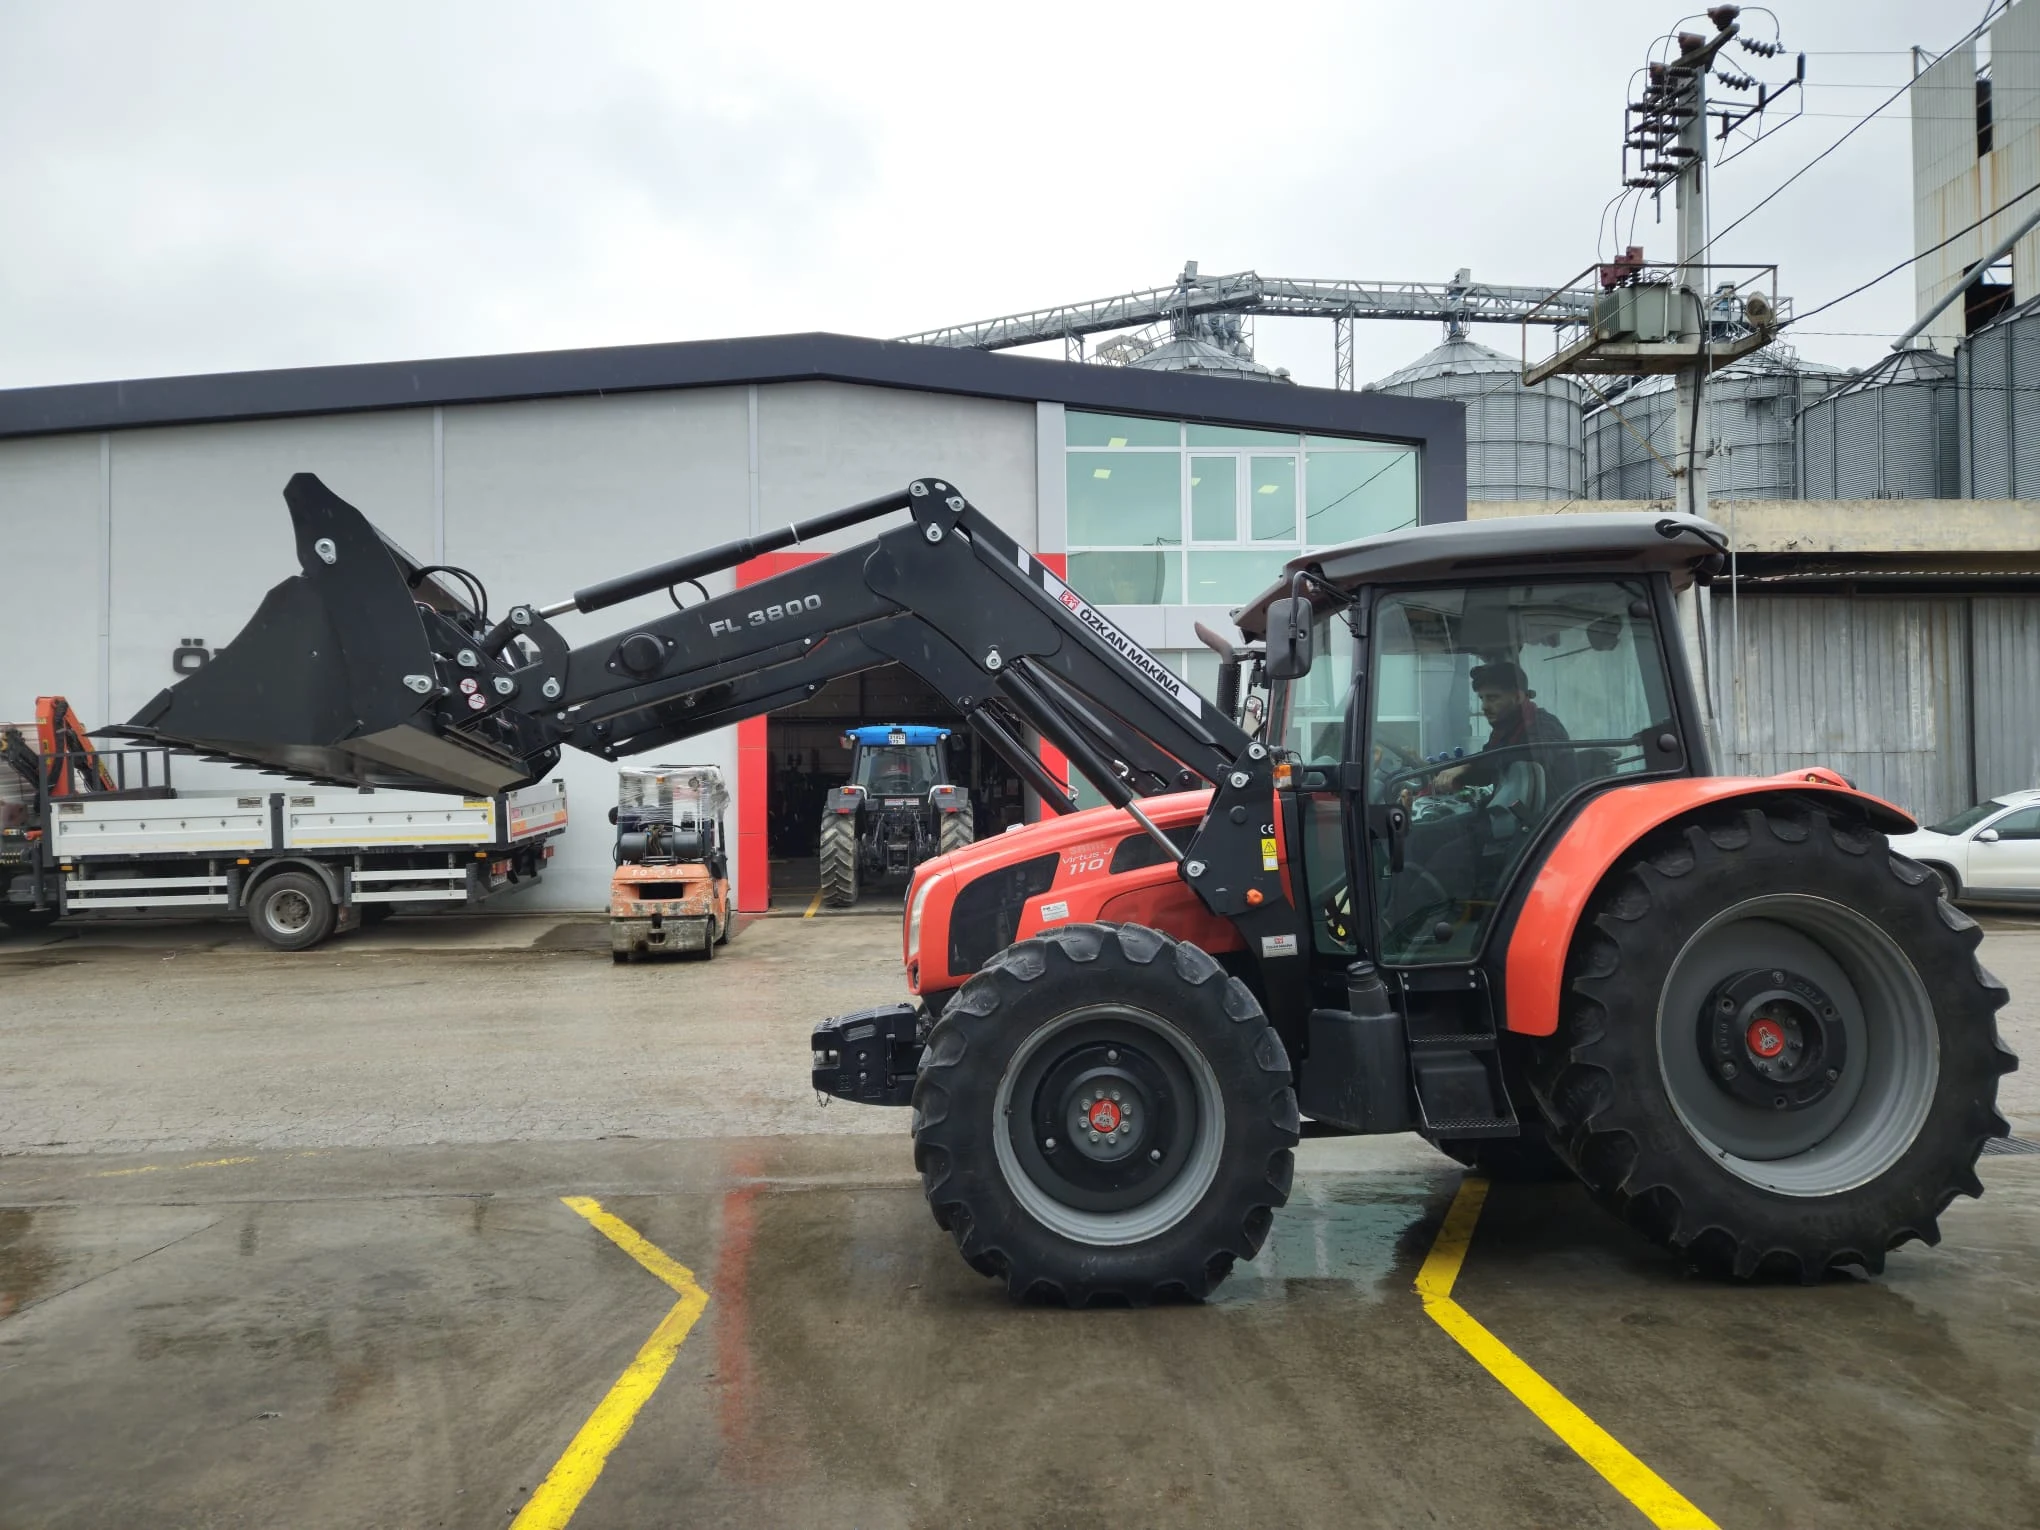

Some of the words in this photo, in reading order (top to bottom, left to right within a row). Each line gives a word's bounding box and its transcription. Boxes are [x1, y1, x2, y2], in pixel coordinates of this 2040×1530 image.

[709, 618, 742, 637] FL
[747, 594, 822, 627] 3800
[1080, 608, 1128, 652] ÖZKAN
[1127, 648, 1180, 697] MAKİNA
[1070, 858, 1105, 875] 110
